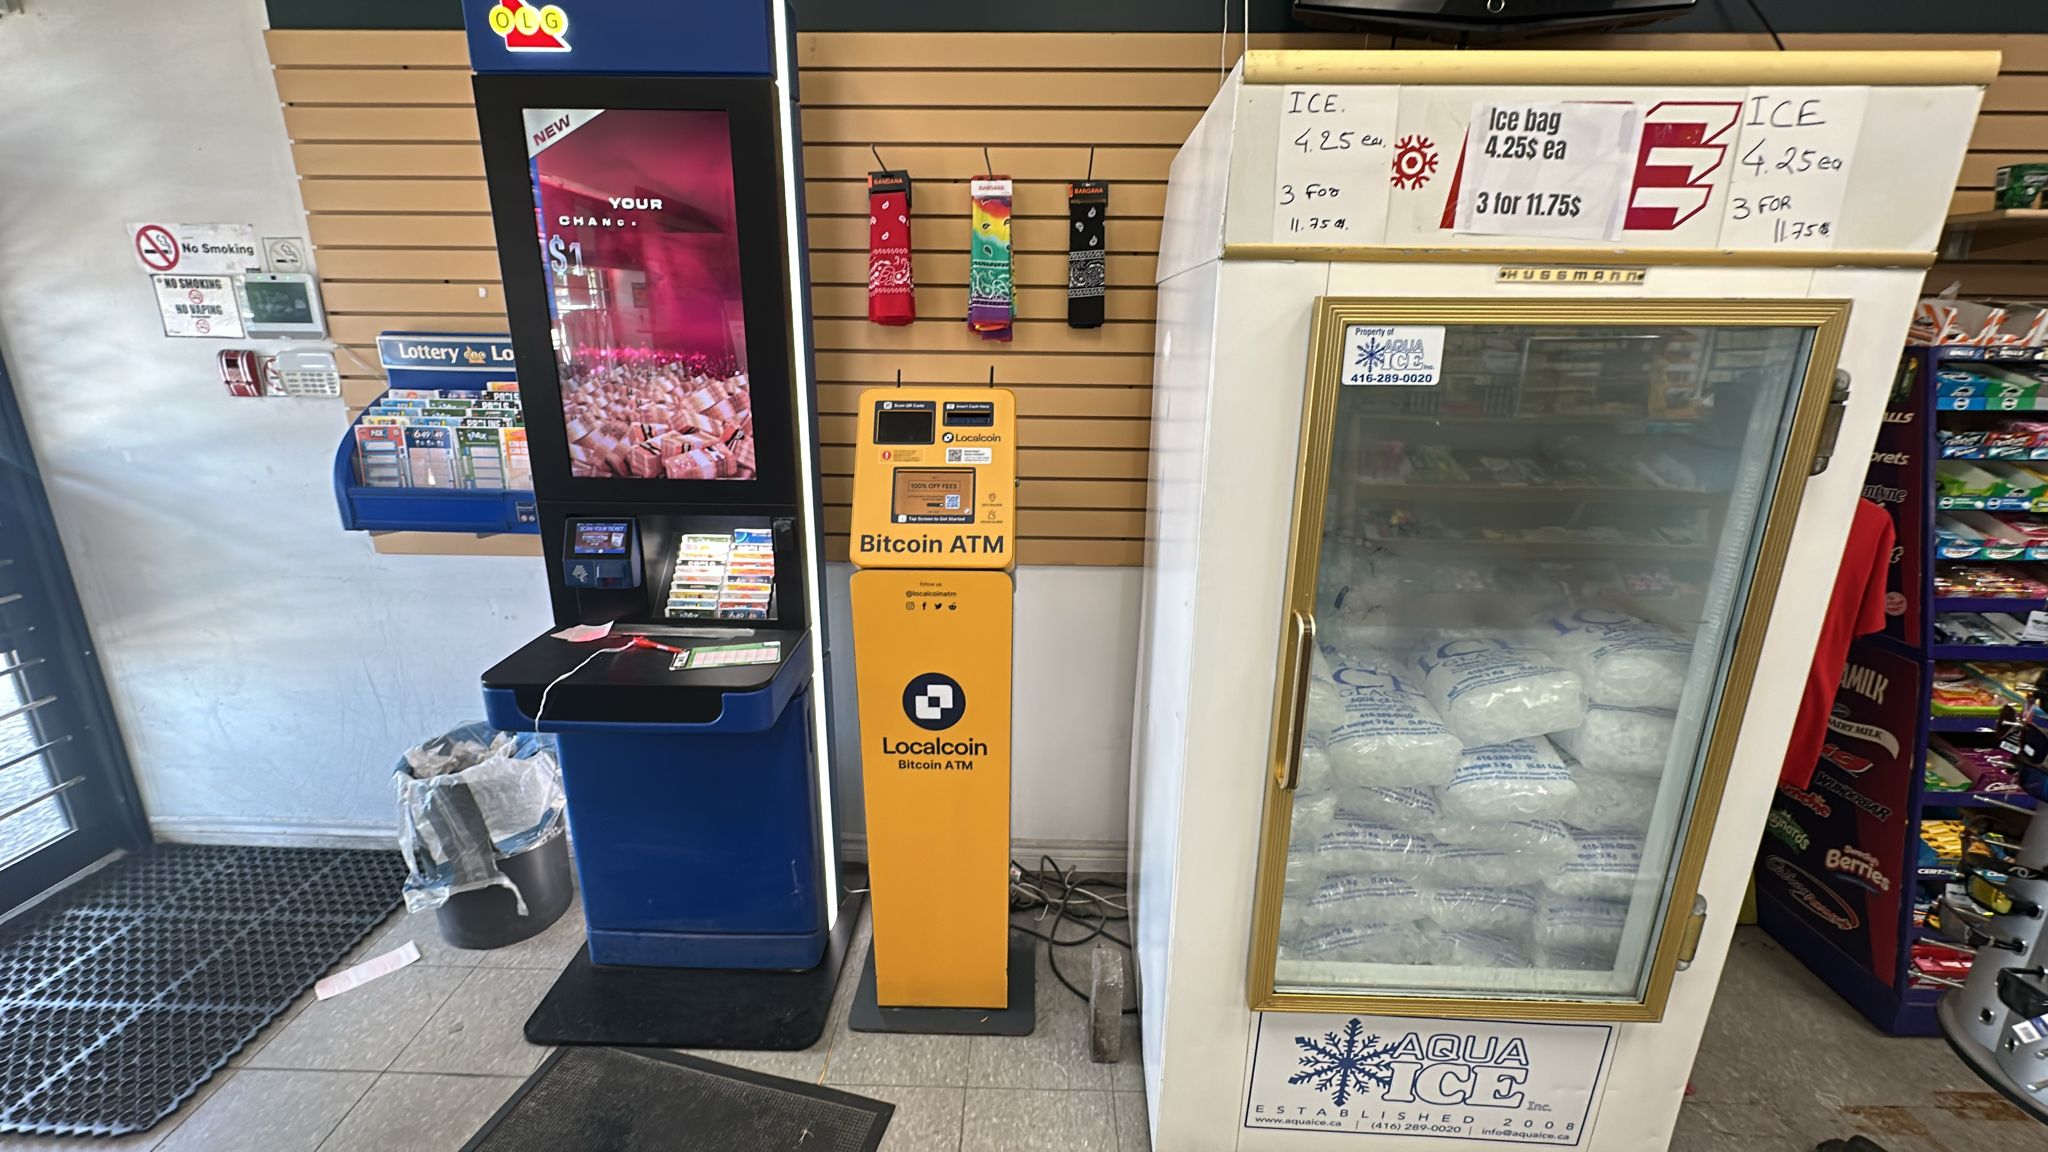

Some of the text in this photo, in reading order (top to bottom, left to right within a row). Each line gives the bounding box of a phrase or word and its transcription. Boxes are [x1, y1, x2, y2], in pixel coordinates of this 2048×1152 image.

[495, 12, 558, 29] OLG
[1488, 107, 1562, 136] Ice bag
[1746, 96, 1827, 129] ICE
[533, 115, 571, 146] NEW
[1294, 127, 1355, 153] 4.25
[1484, 136, 1567, 161] 4.25$ ea
[1741, 138, 1815, 176] 4.25
[608, 197, 662, 210] YOUR
[1280, 184, 1295, 206] 3
[1476, 192, 1582, 218] 3 for 11.75$
[1732, 195, 1792, 220] 3 FOR
[181, 243, 254, 257] No Smoking
[164, 278, 222, 290] NO SMOKING
[1507, 269, 1638, 281] HUSSMANN
[175, 304, 223, 315] NO VAPING
[1355, 328, 1386, 337] Property
[398, 343, 459, 364] Lottery
[490, 345, 515, 361] Lo
[1384, 339, 1424, 352] AQUA
[1381, 351, 1424, 371] ICE
[1350, 373, 1432, 383] 416-289-0020
[955, 433, 1001, 442] Localcoin
[941, 482, 958, 490] FEES
[860, 534, 1004, 554] Bitcoin ATM
[905, 590, 957, 598] @localcoinatm
[1841, 662, 1889, 705] AMILK
[882, 737, 987, 756] Localcoin
[898, 759, 973, 770] Bitcoin ATM
[1826, 849, 1890, 891] Berries
[1389, 1032, 1529, 1066] AQUA
[1381, 1061, 1529, 1109] ICE
[1527, 1100, 1552, 1113] Inc.
[1255, 1104, 1574, 1131] ESTABLISHED 2008
[1255, 1116, 1570, 1141] www.aquaice.ca (416) 289-0020 info@aquaice.ca
